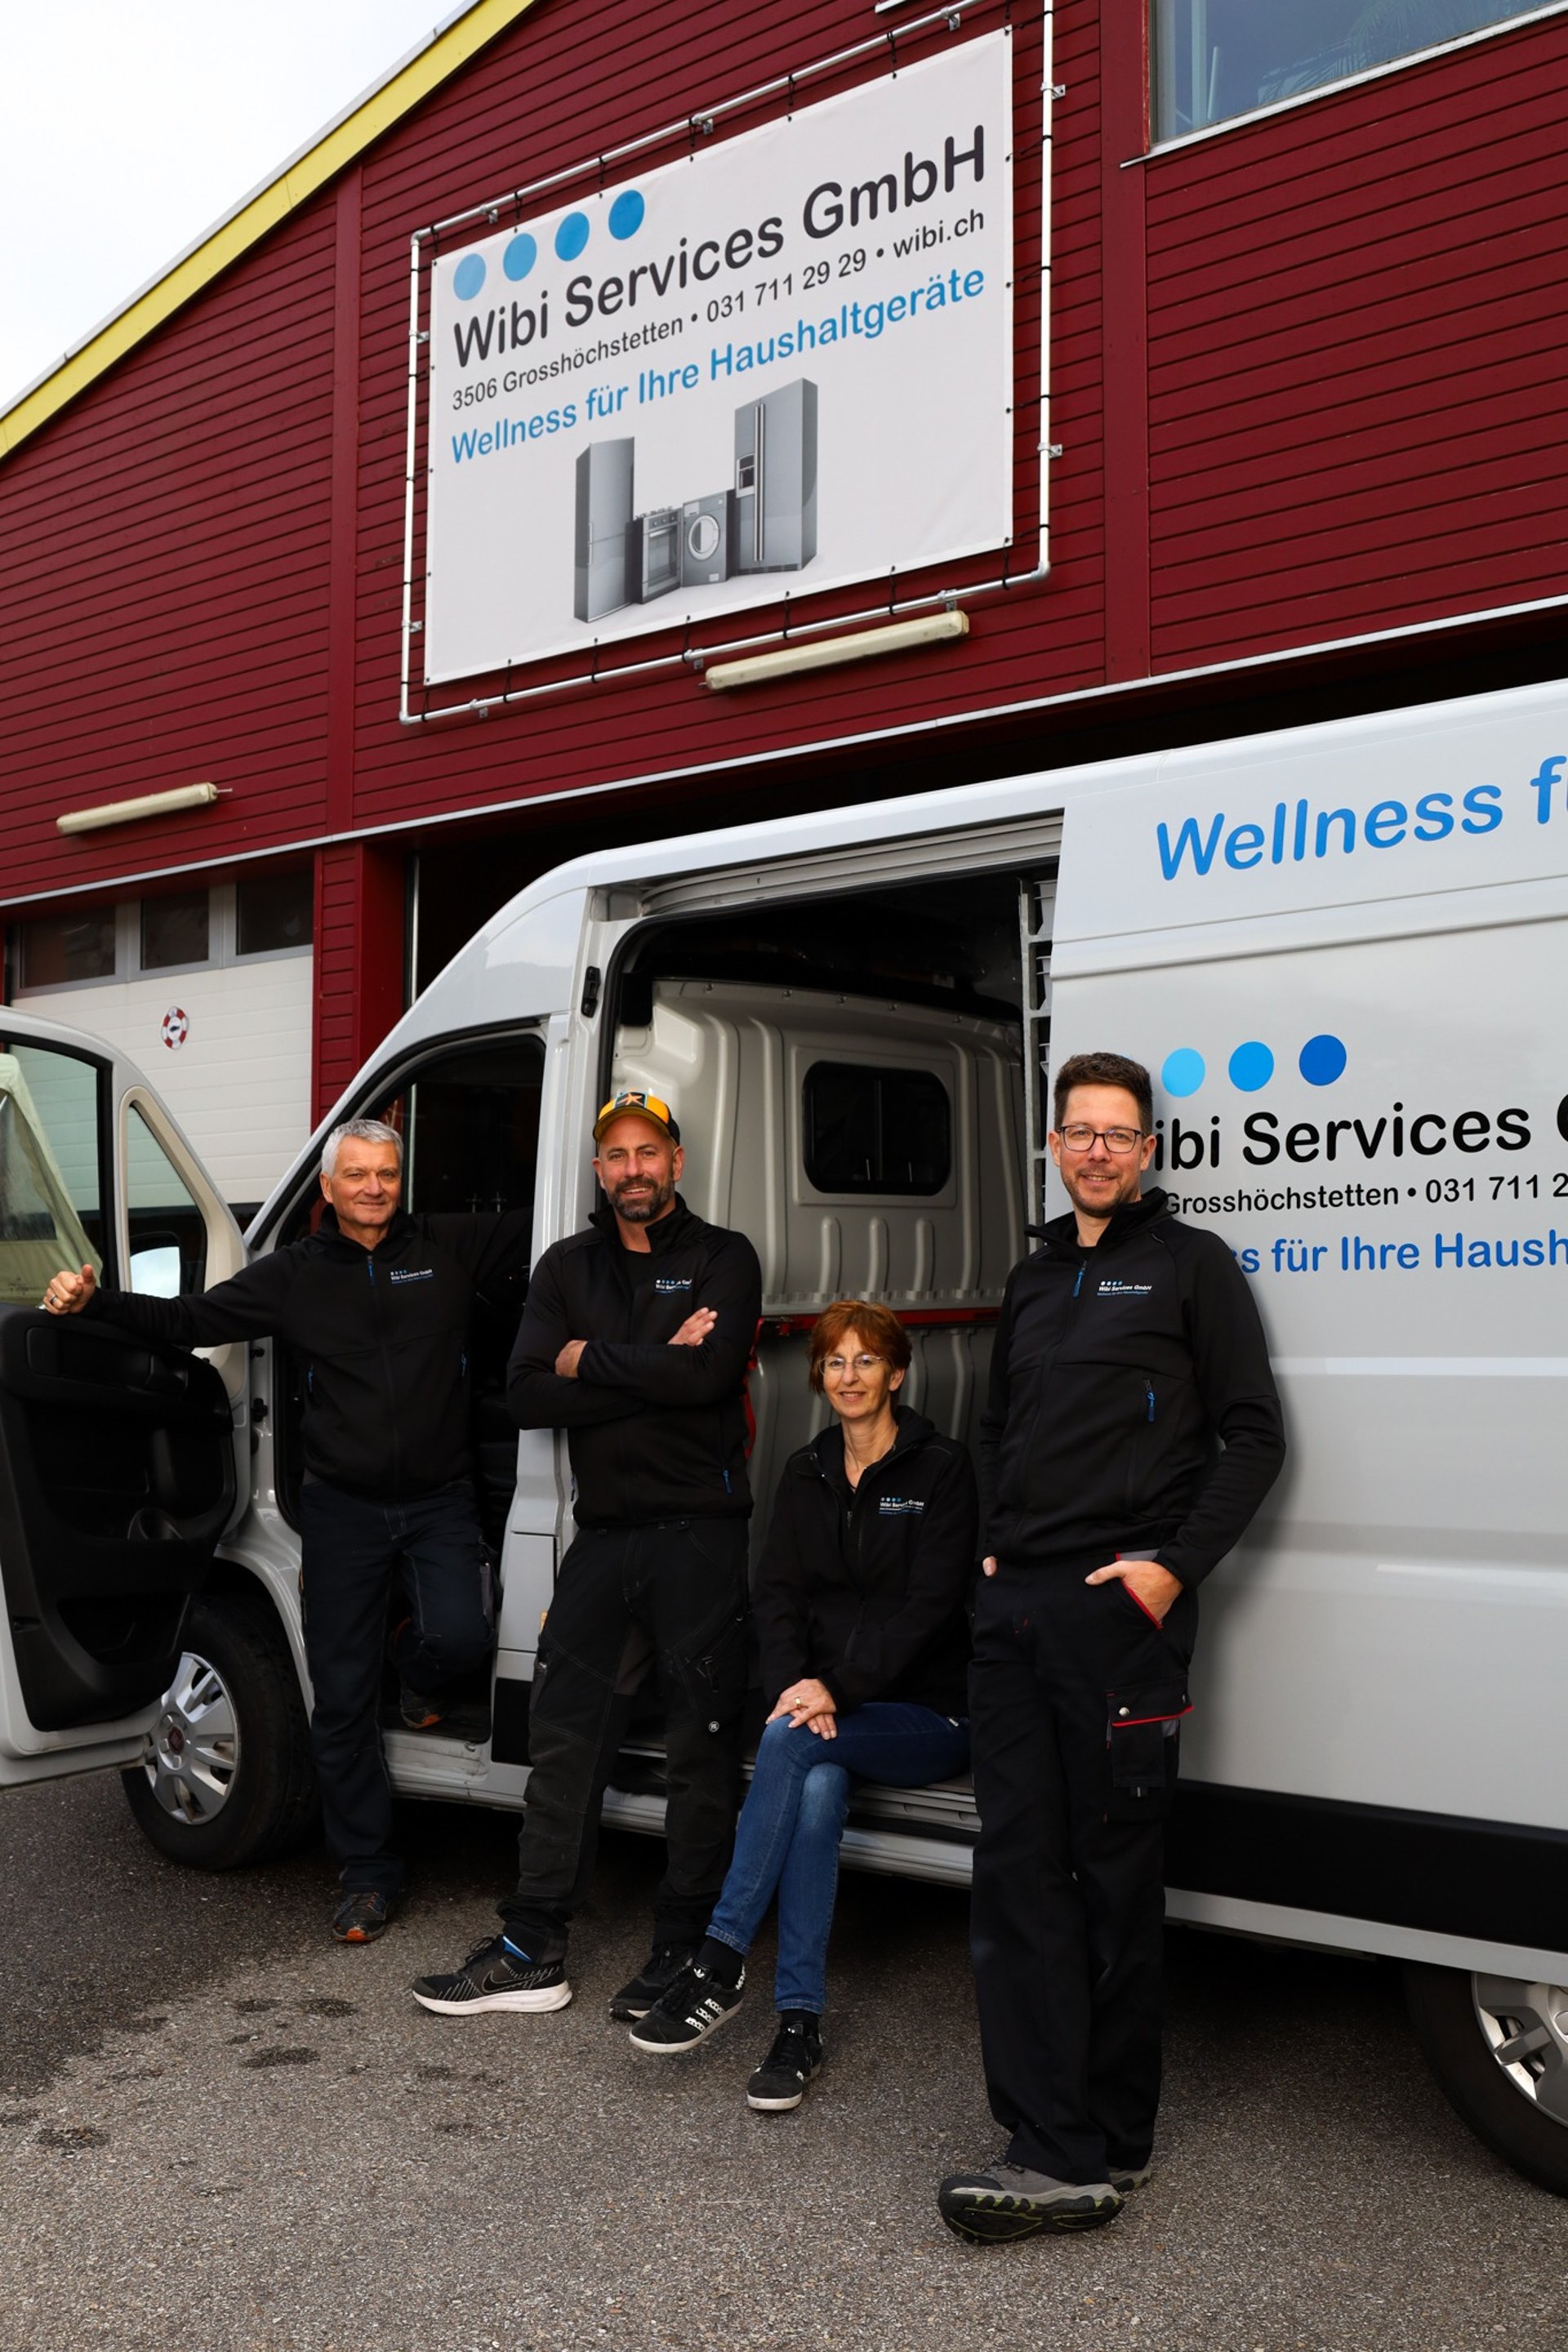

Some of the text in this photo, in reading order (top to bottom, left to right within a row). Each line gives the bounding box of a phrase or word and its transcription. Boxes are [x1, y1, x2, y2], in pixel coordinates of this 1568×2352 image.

[453, 125, 984, 368] Wibi Services GmbH
[452, 209, 984, 411] 3506 Grosshöchstetten 031 711 29 29 wibi.ch
[452, 269, 985, 463] Wellness für Ihre Haushaltgeräte
[1156, 783, 1504, 881] Wellness
[1154, 1116, 1220, 1171] ibi
[1242, 1102, 1531, 1166] Services
[1168, 1183, 1399, 1215] Grosshöchstetten
[1425, 1178, 1475, 1203] 031
[1489, 1174, 1538, 1200] 711
[1271, 1238, 1329, 1273] für
[1340, 1236, 1419, 1272] Ihre
